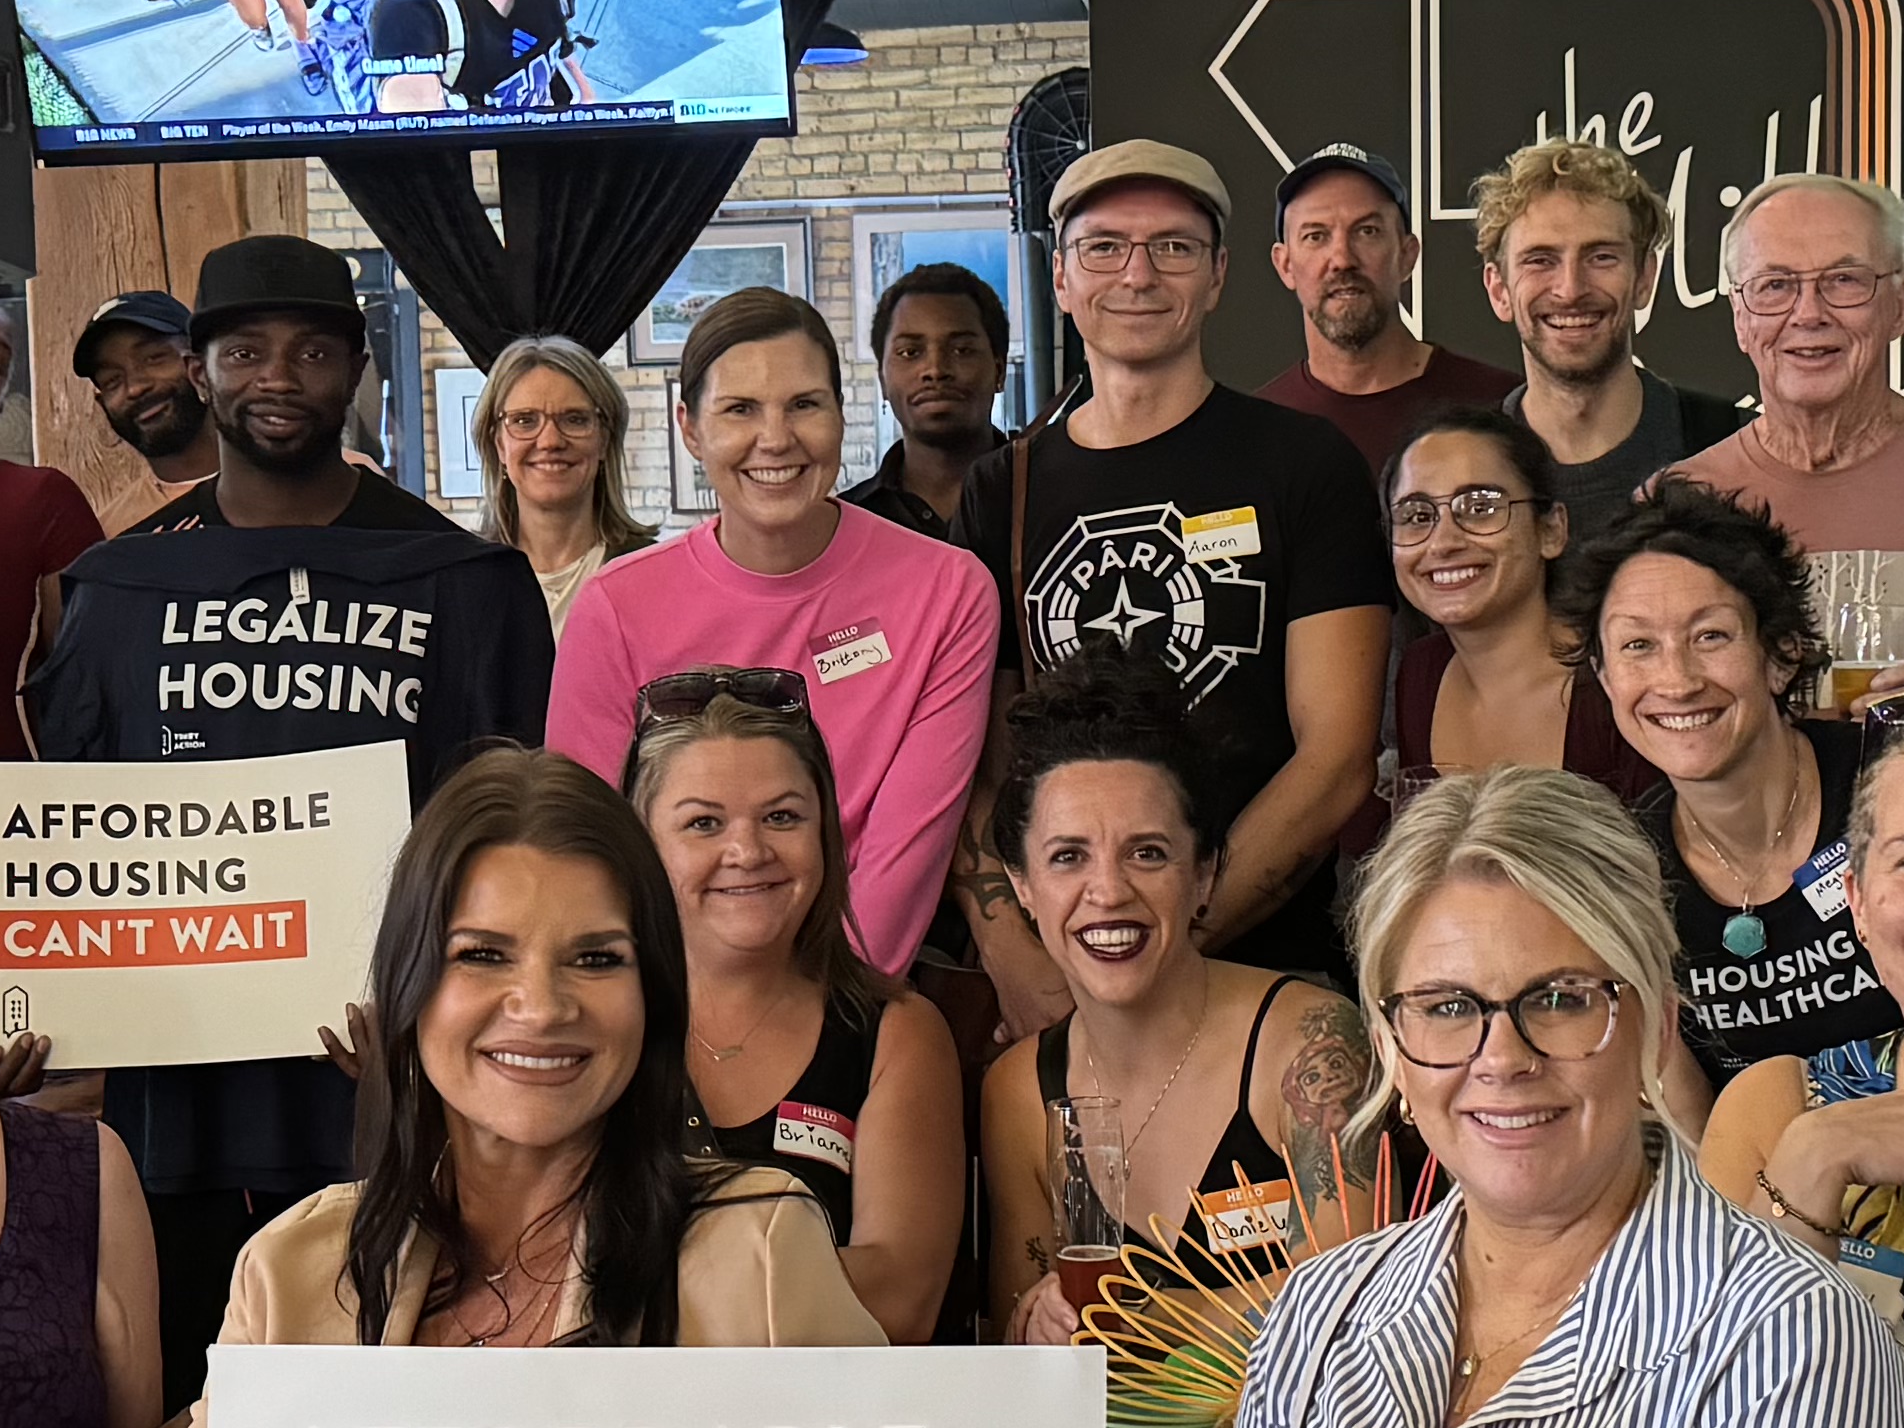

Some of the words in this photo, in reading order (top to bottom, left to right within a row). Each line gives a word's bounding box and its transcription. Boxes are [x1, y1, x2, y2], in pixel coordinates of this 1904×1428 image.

[1071, 539, 1175, 591] PÂRI
[1187, 537, 1238, 556] Aaron
[162, 597, 433, 658] LEGALIZE
[827, 625, 859, 644] HELLO
[158, 661, 424, 724] HOUSING
[2, 791, 331, 840] AFFORDABLE
[5, 857, 247, 899] HOUSING
[1812, 841, 1847, 870] HELLO
[3, 918, 155, 958] CAN'T
[168, 910, 294, 954] WAIT
[1689, 930, 1856, 997] HOUSING
[1839, 1239, 1876, 1260] ELLO
